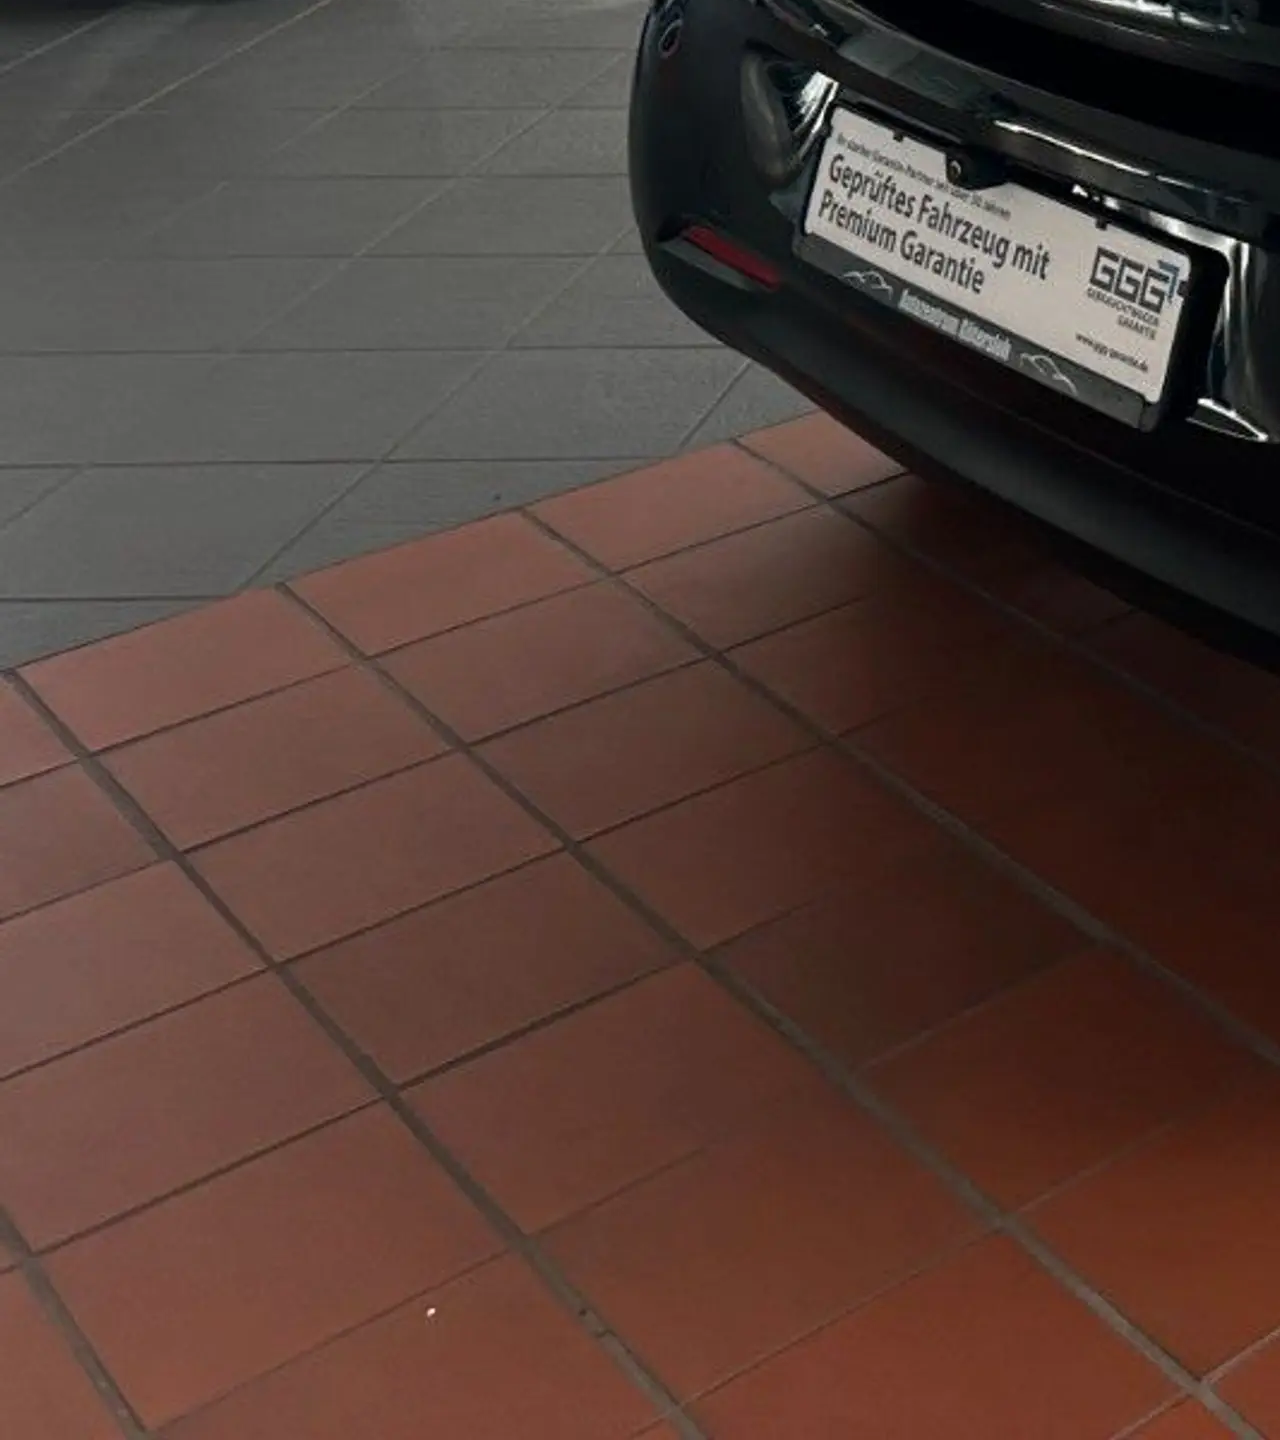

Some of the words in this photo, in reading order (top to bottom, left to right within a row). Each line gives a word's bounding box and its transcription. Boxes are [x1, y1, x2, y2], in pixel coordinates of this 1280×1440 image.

[818, 188, 898, 254] Premium
[899, 230, 986, 294] Garantie
[829, 153, 917, 218] Geprüftes
[917, 193, 1011, 269] Fahrzeug
[1011, 241, 1052, 280] mit
[1089, 246, 1166, 314] GGG
